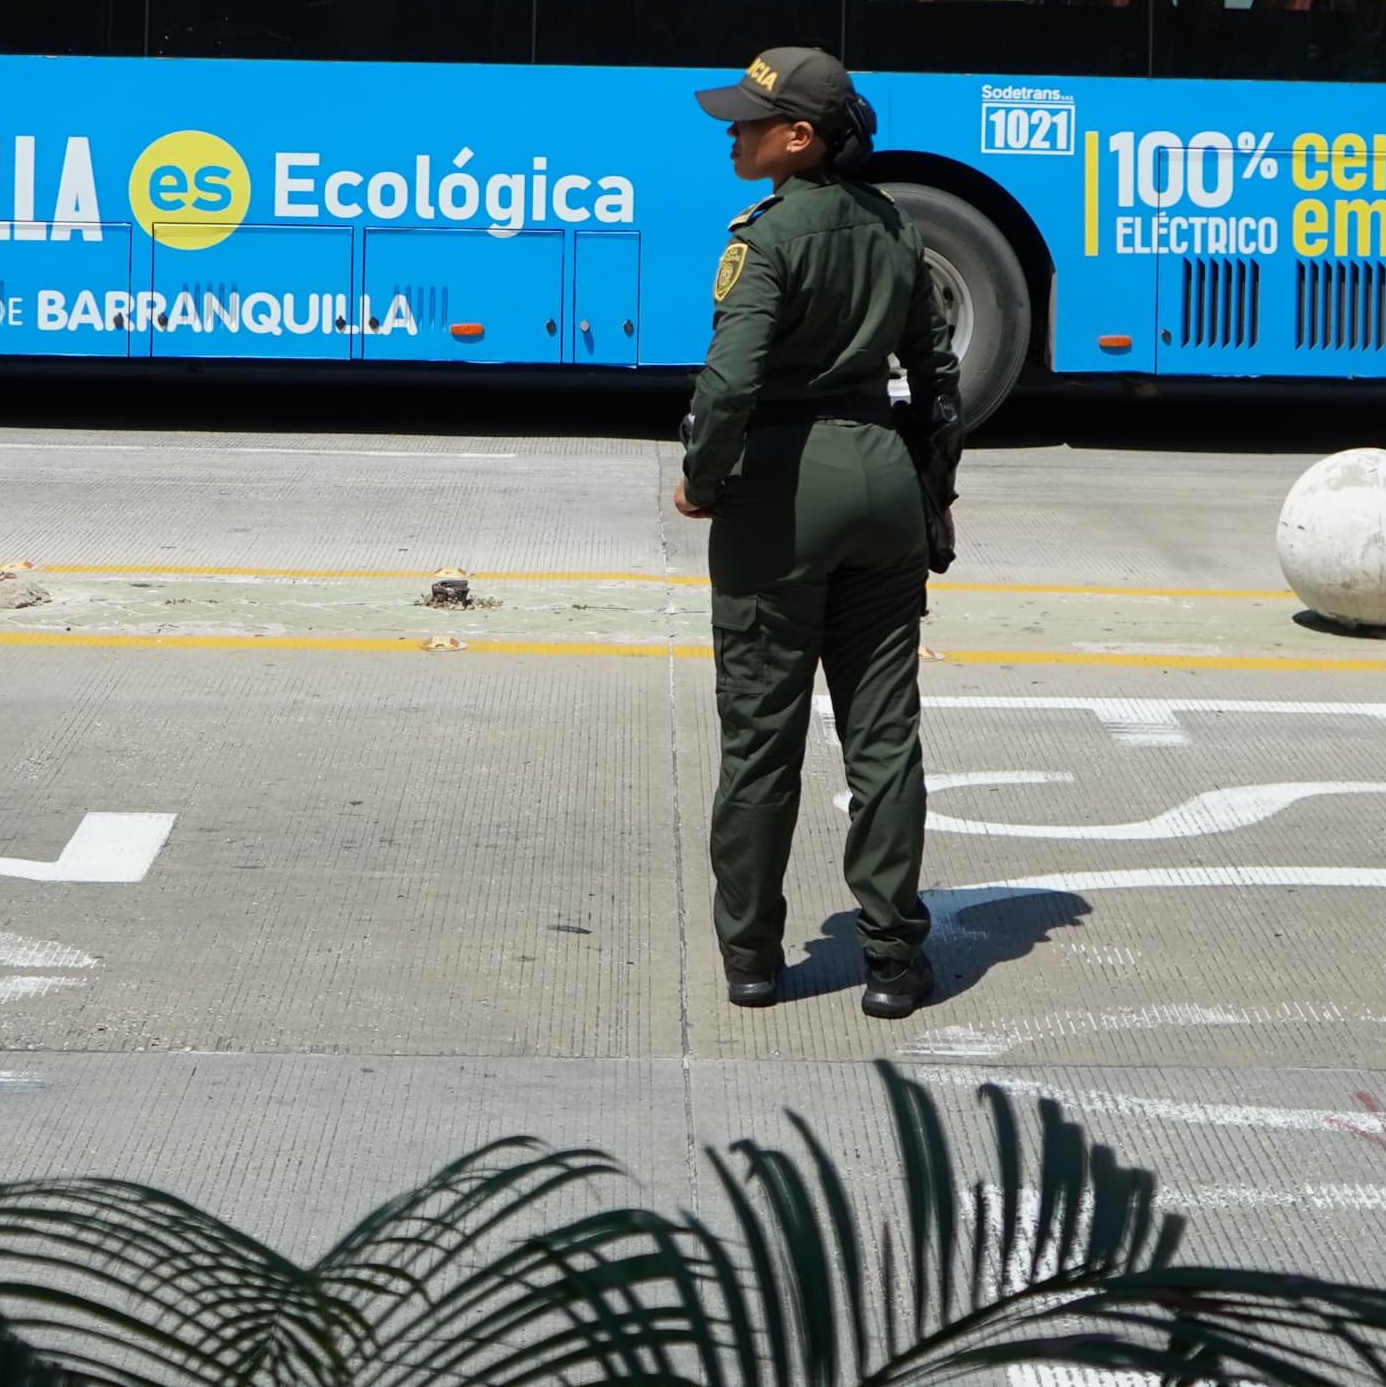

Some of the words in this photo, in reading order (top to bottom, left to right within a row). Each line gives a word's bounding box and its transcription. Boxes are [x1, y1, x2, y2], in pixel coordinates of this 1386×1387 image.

[981, 84, 1061, 101] Sodetrans
[989, 109, 1068, 150] 1021
[1109, 130, 1278, 208] 100%
[148, 163, 233, 213] es
[274, 146, 635, 239] Ecológica
[1116, 211, 1278, 254] ELÉCTRICO
[37, 289, 419, 337] BARRANQUILLA
